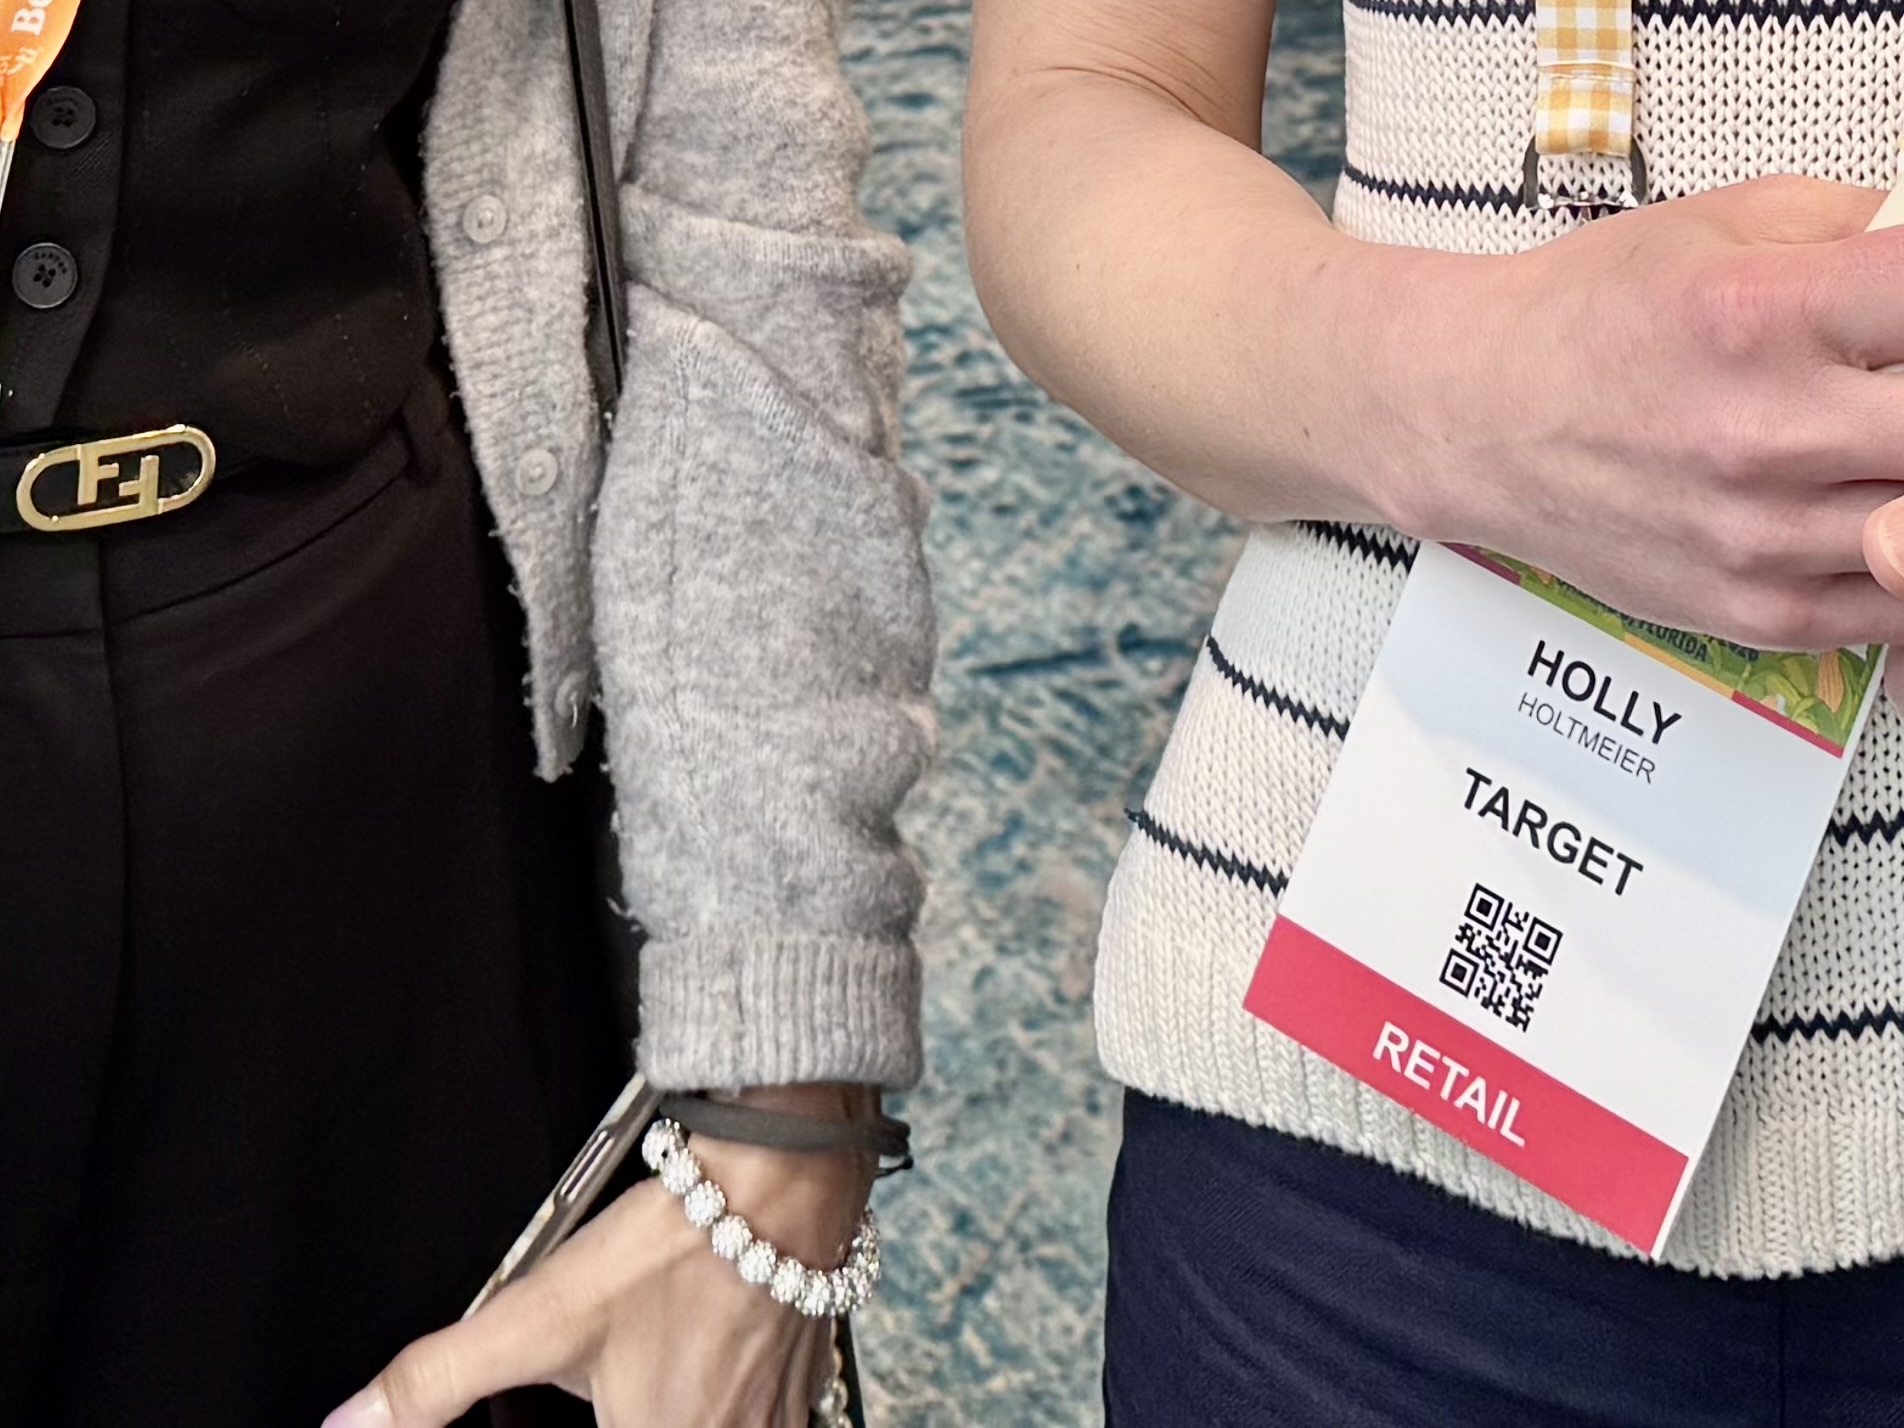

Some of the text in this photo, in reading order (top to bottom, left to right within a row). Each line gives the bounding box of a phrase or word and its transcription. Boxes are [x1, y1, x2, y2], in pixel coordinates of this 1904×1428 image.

[1517, 693, 1657, 785] HOLTMEIER
[1526, 640, 1682, 747] HOLLY
[1463, 768, 1644, 897] TARGET
[1373, 1021, 1526, 1147] RETAIL
